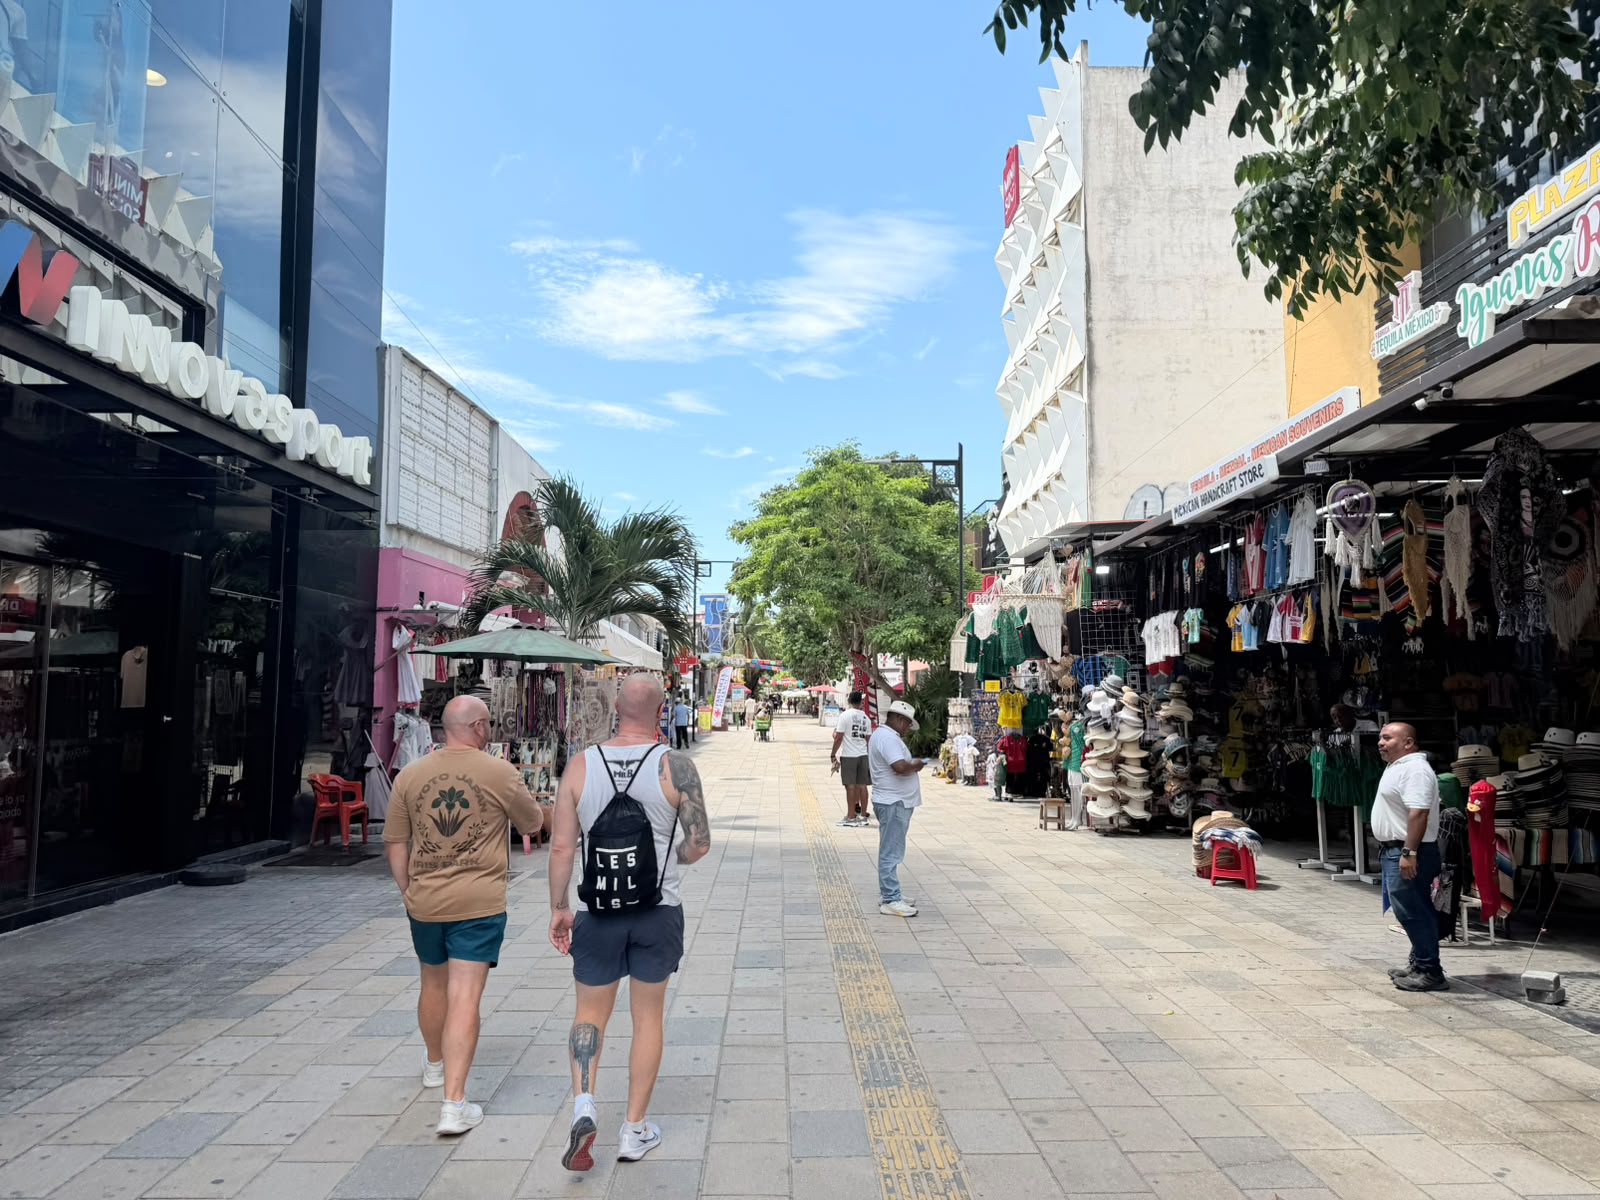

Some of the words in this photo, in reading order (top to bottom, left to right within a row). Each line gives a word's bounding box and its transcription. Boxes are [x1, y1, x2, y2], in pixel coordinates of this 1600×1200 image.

[1459, 239, 1570, 347] Iguanas
[1375, 327, 1403, 355] TEQUILA
[1190, 471, 1217, 494] TEQUILA
[1219, 453, 1247, 478] MEZCAL
[1251, 429, 1288, 461] MEXICAN
[1288, 397, 1344, 444] SOUVENIRS
[1230, 751, 1240, 768] 7
[415, 773, 450, 813] KYOTO
[455, 773, 489, 813] JAPAN
[413, 859, 438, 869] IRIS
[441, 858, 481, 869] PARK
[595, 852, 637, 869] LES
[595, 875, 637, 891] MIL
[595, 897, 622, 909] LS
